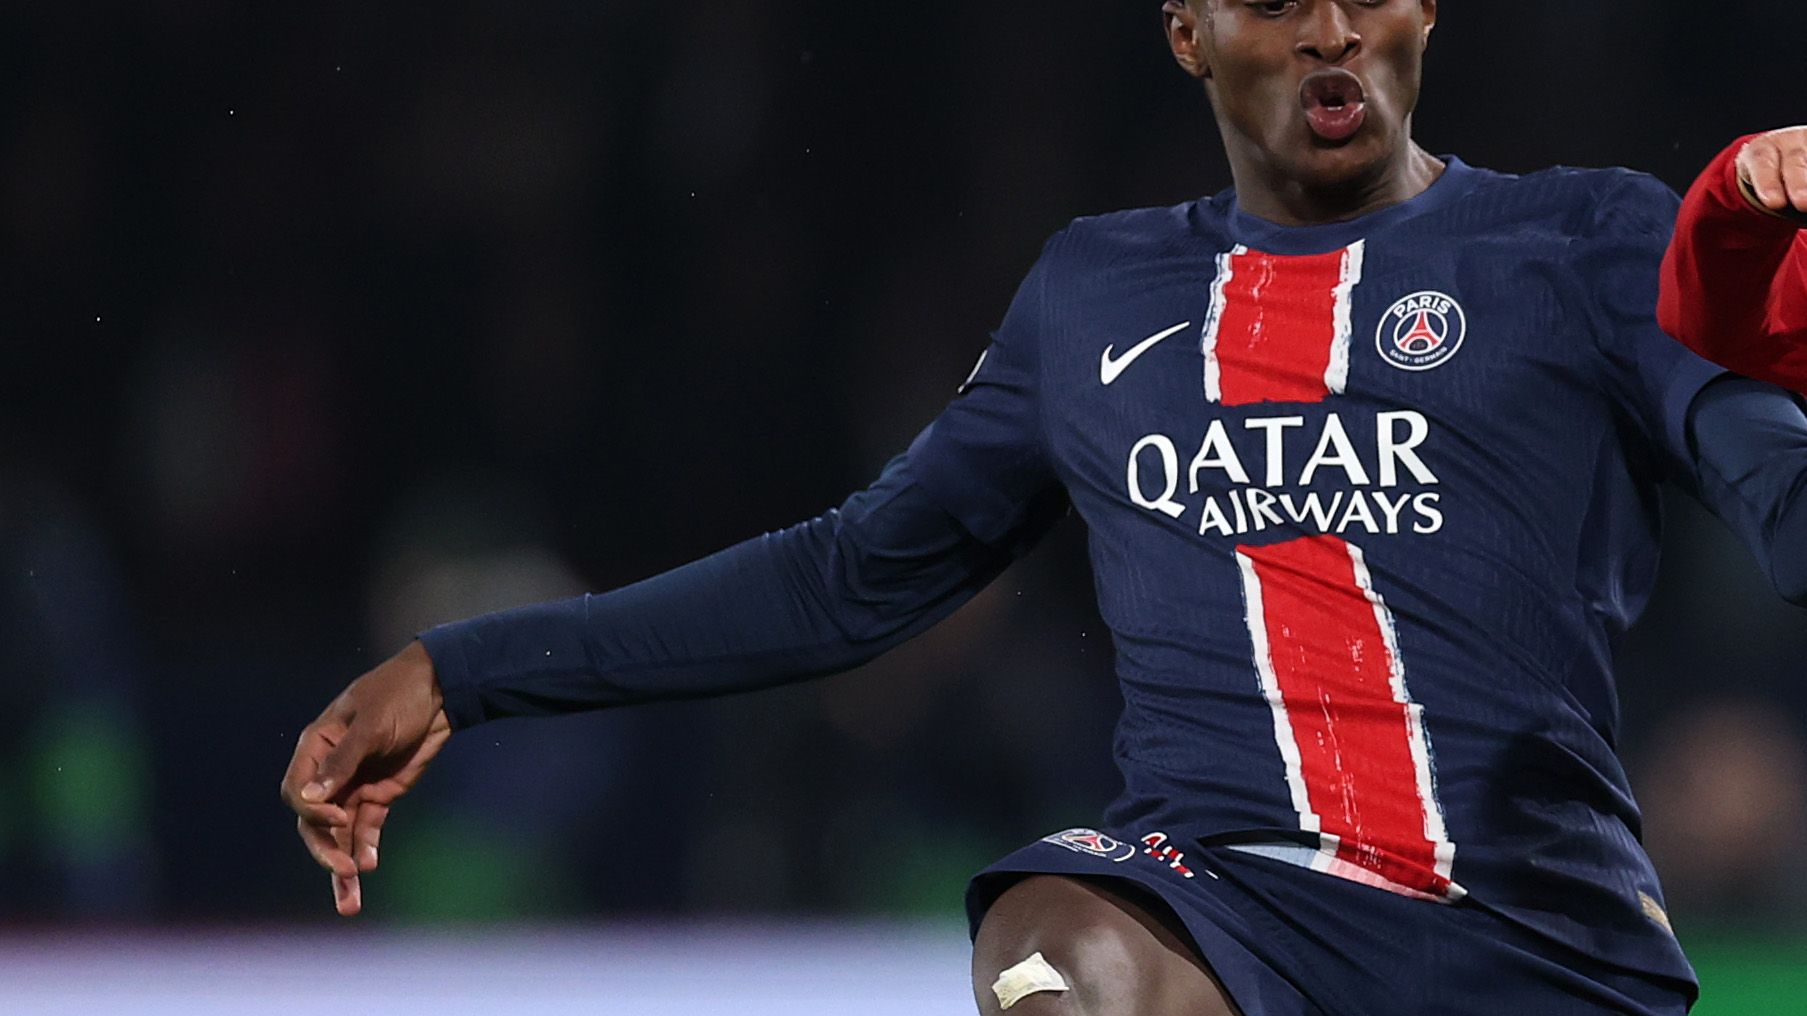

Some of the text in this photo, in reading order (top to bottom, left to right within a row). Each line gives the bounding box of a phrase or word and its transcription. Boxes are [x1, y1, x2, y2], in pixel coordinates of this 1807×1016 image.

[1393, 296, 1451, 318] PARIS
[1127, 410, 1440, 519] QATAR
[1199, 487, 1443, 536] AIRWAYS
